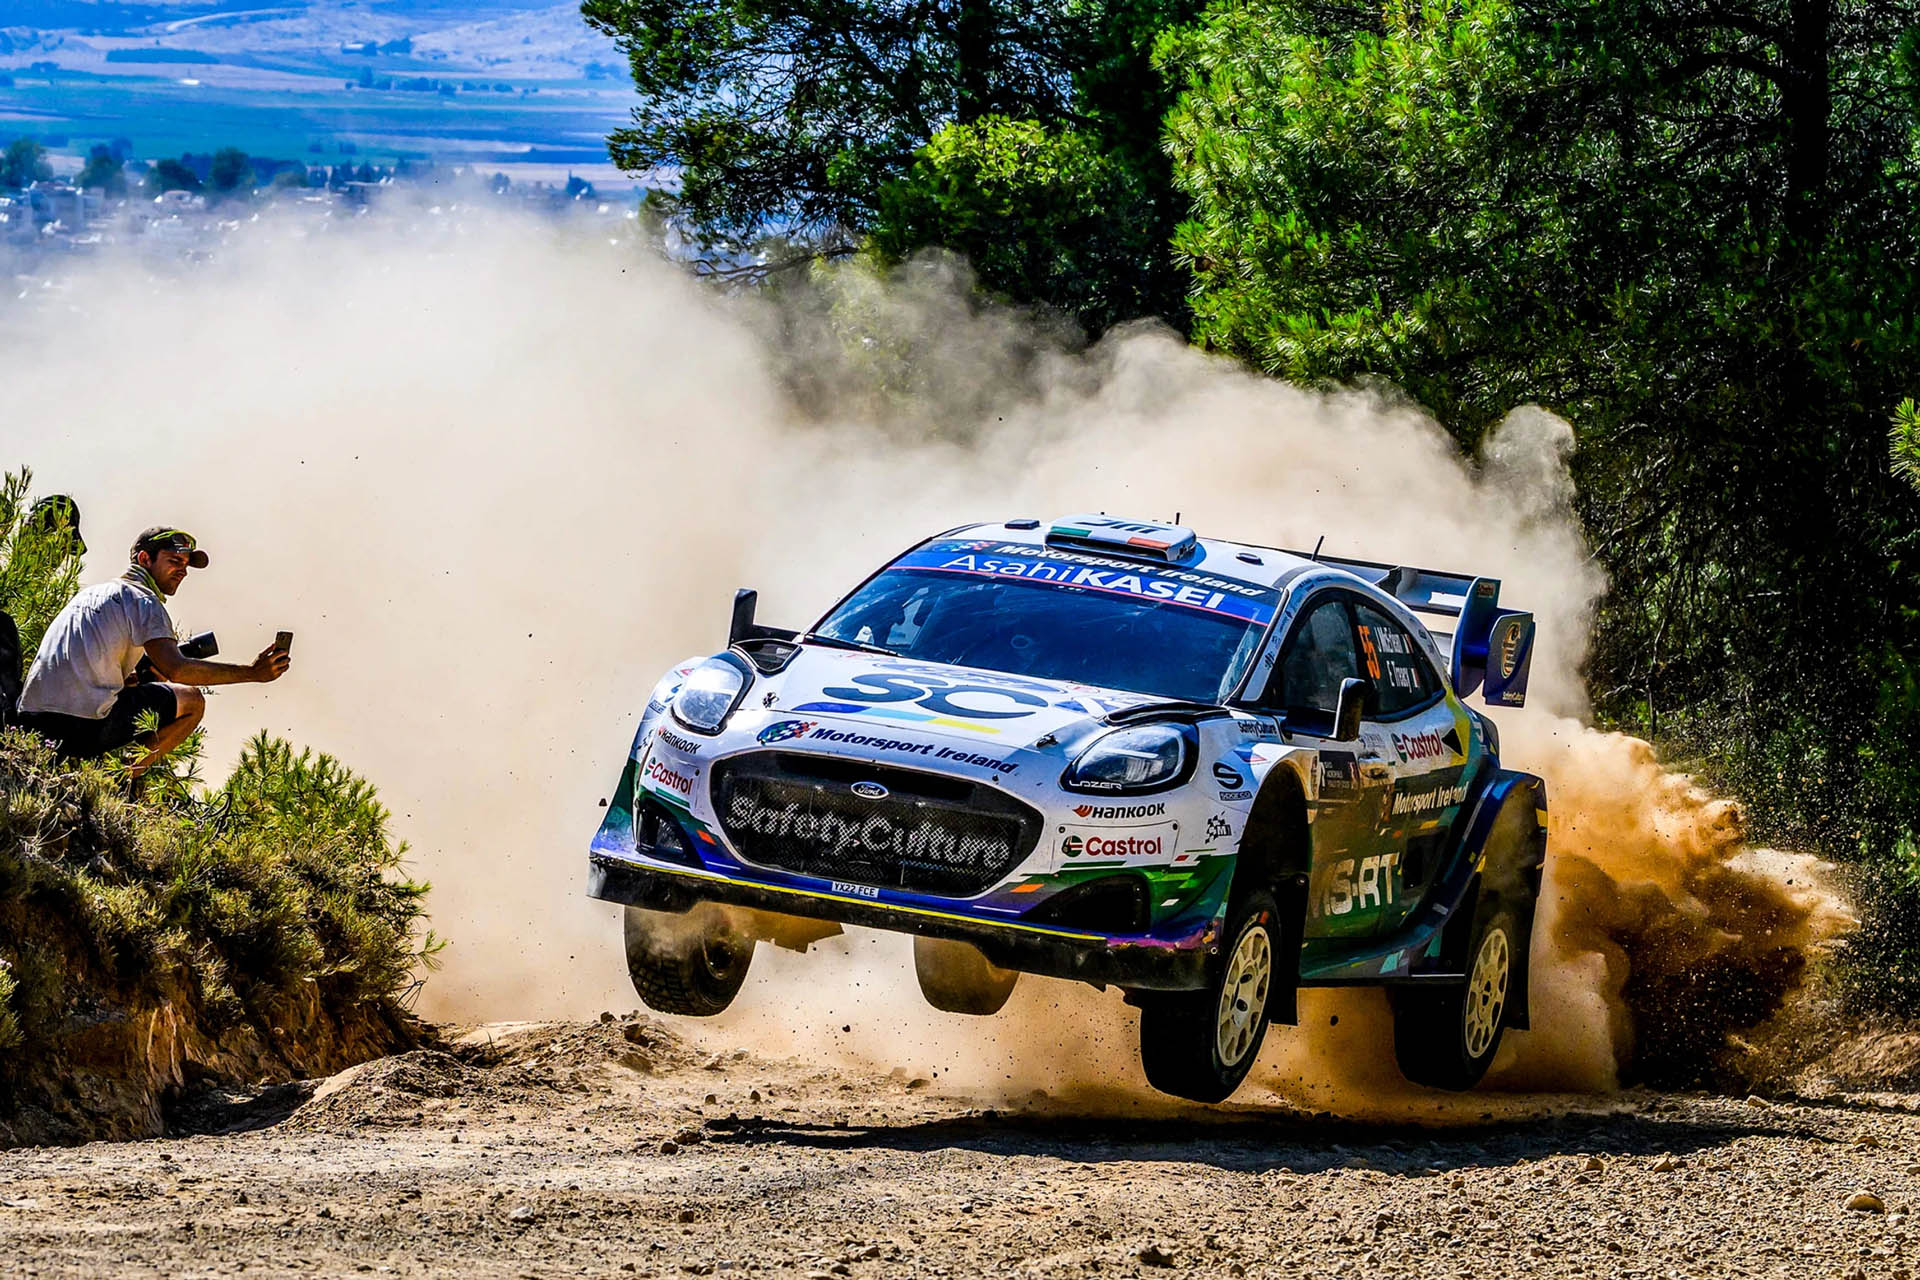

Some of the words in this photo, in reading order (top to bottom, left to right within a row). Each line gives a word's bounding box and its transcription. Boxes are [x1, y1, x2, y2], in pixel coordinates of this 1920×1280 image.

[940, 555, 1226, 609] AsahiKASEI
[994, 550, 1156, 574] Motorsport
[1157, 569, 1267, 597] Ireland
[822, 673, 1049, 720] SC
[809, 727, 935, 756] Motorsport
[935, 746, 1021, 775] Ireland
[1401, 728, 1444, 760] Castrol
[651, 762, 694, 796] Castrol
[858, 784, 881, 797] Ford
[1392, 788, 1437, 815] Motorsport
[725, 796, 1011, 871] SafetyCulture
[1086, 836, 1162, 857] Castrol
[834, 883, 856, 894] YX22
[858, 886, 876, 897] FCE
